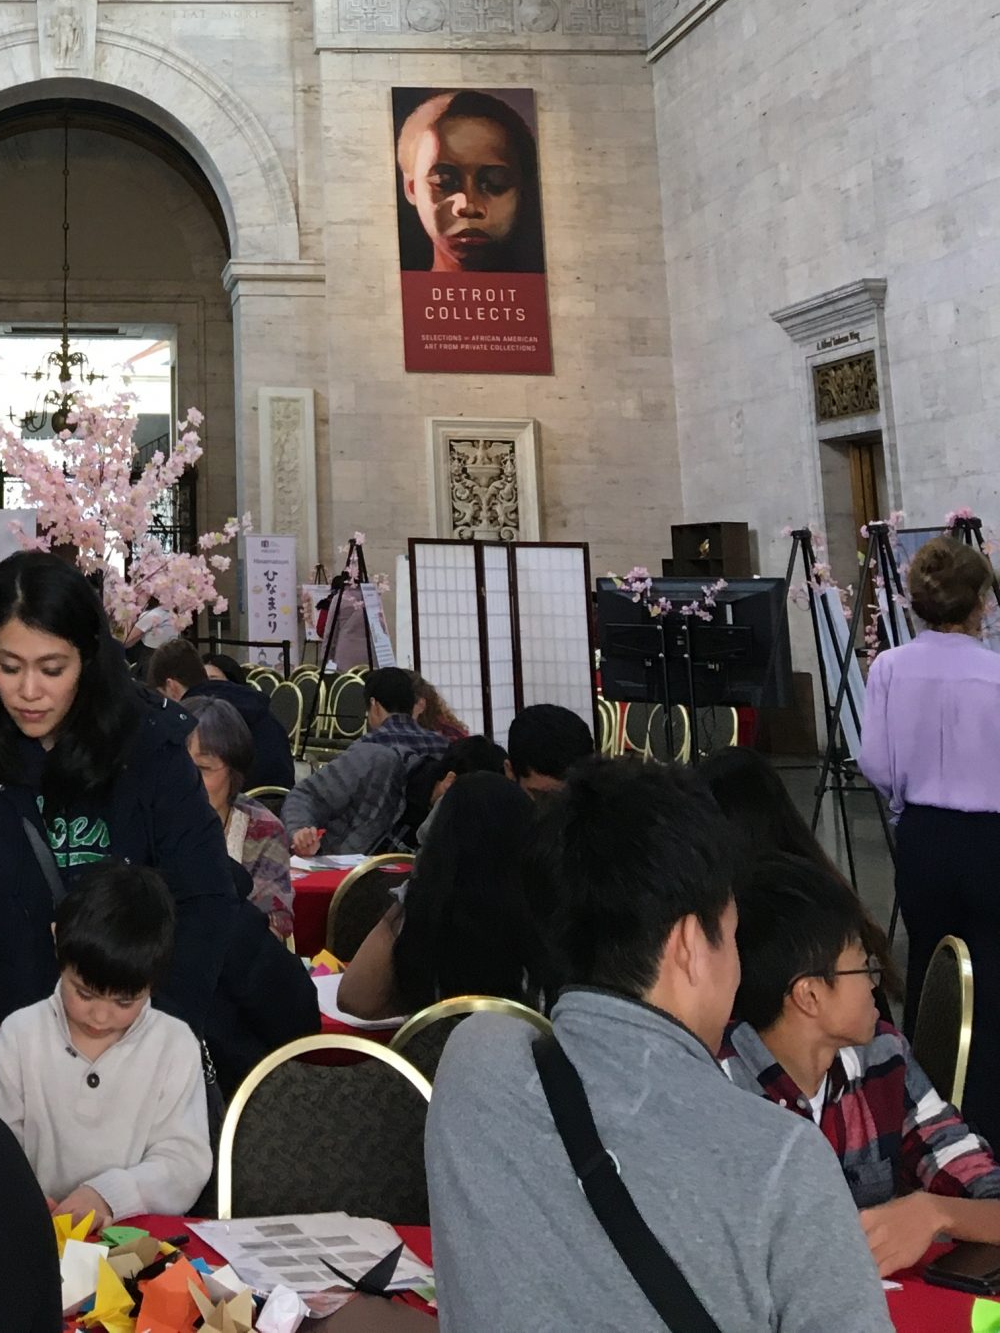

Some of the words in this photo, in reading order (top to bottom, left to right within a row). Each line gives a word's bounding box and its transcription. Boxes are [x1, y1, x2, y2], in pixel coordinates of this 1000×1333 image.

[432, 287, 517, 303] DETROIT
[425, 306, 526, 322] COLLECTS
[421, 334, 462, 342] SELECTIONS
[471, 335, 500, 343] AFRICAN
[502, 335, 538, 343] AMERICAN
[460, 343, 488, 351] PRIVATE
[490, 344, 536, 352] COLLECTIONS
[263, 570, 278, 634] ひなまつり
